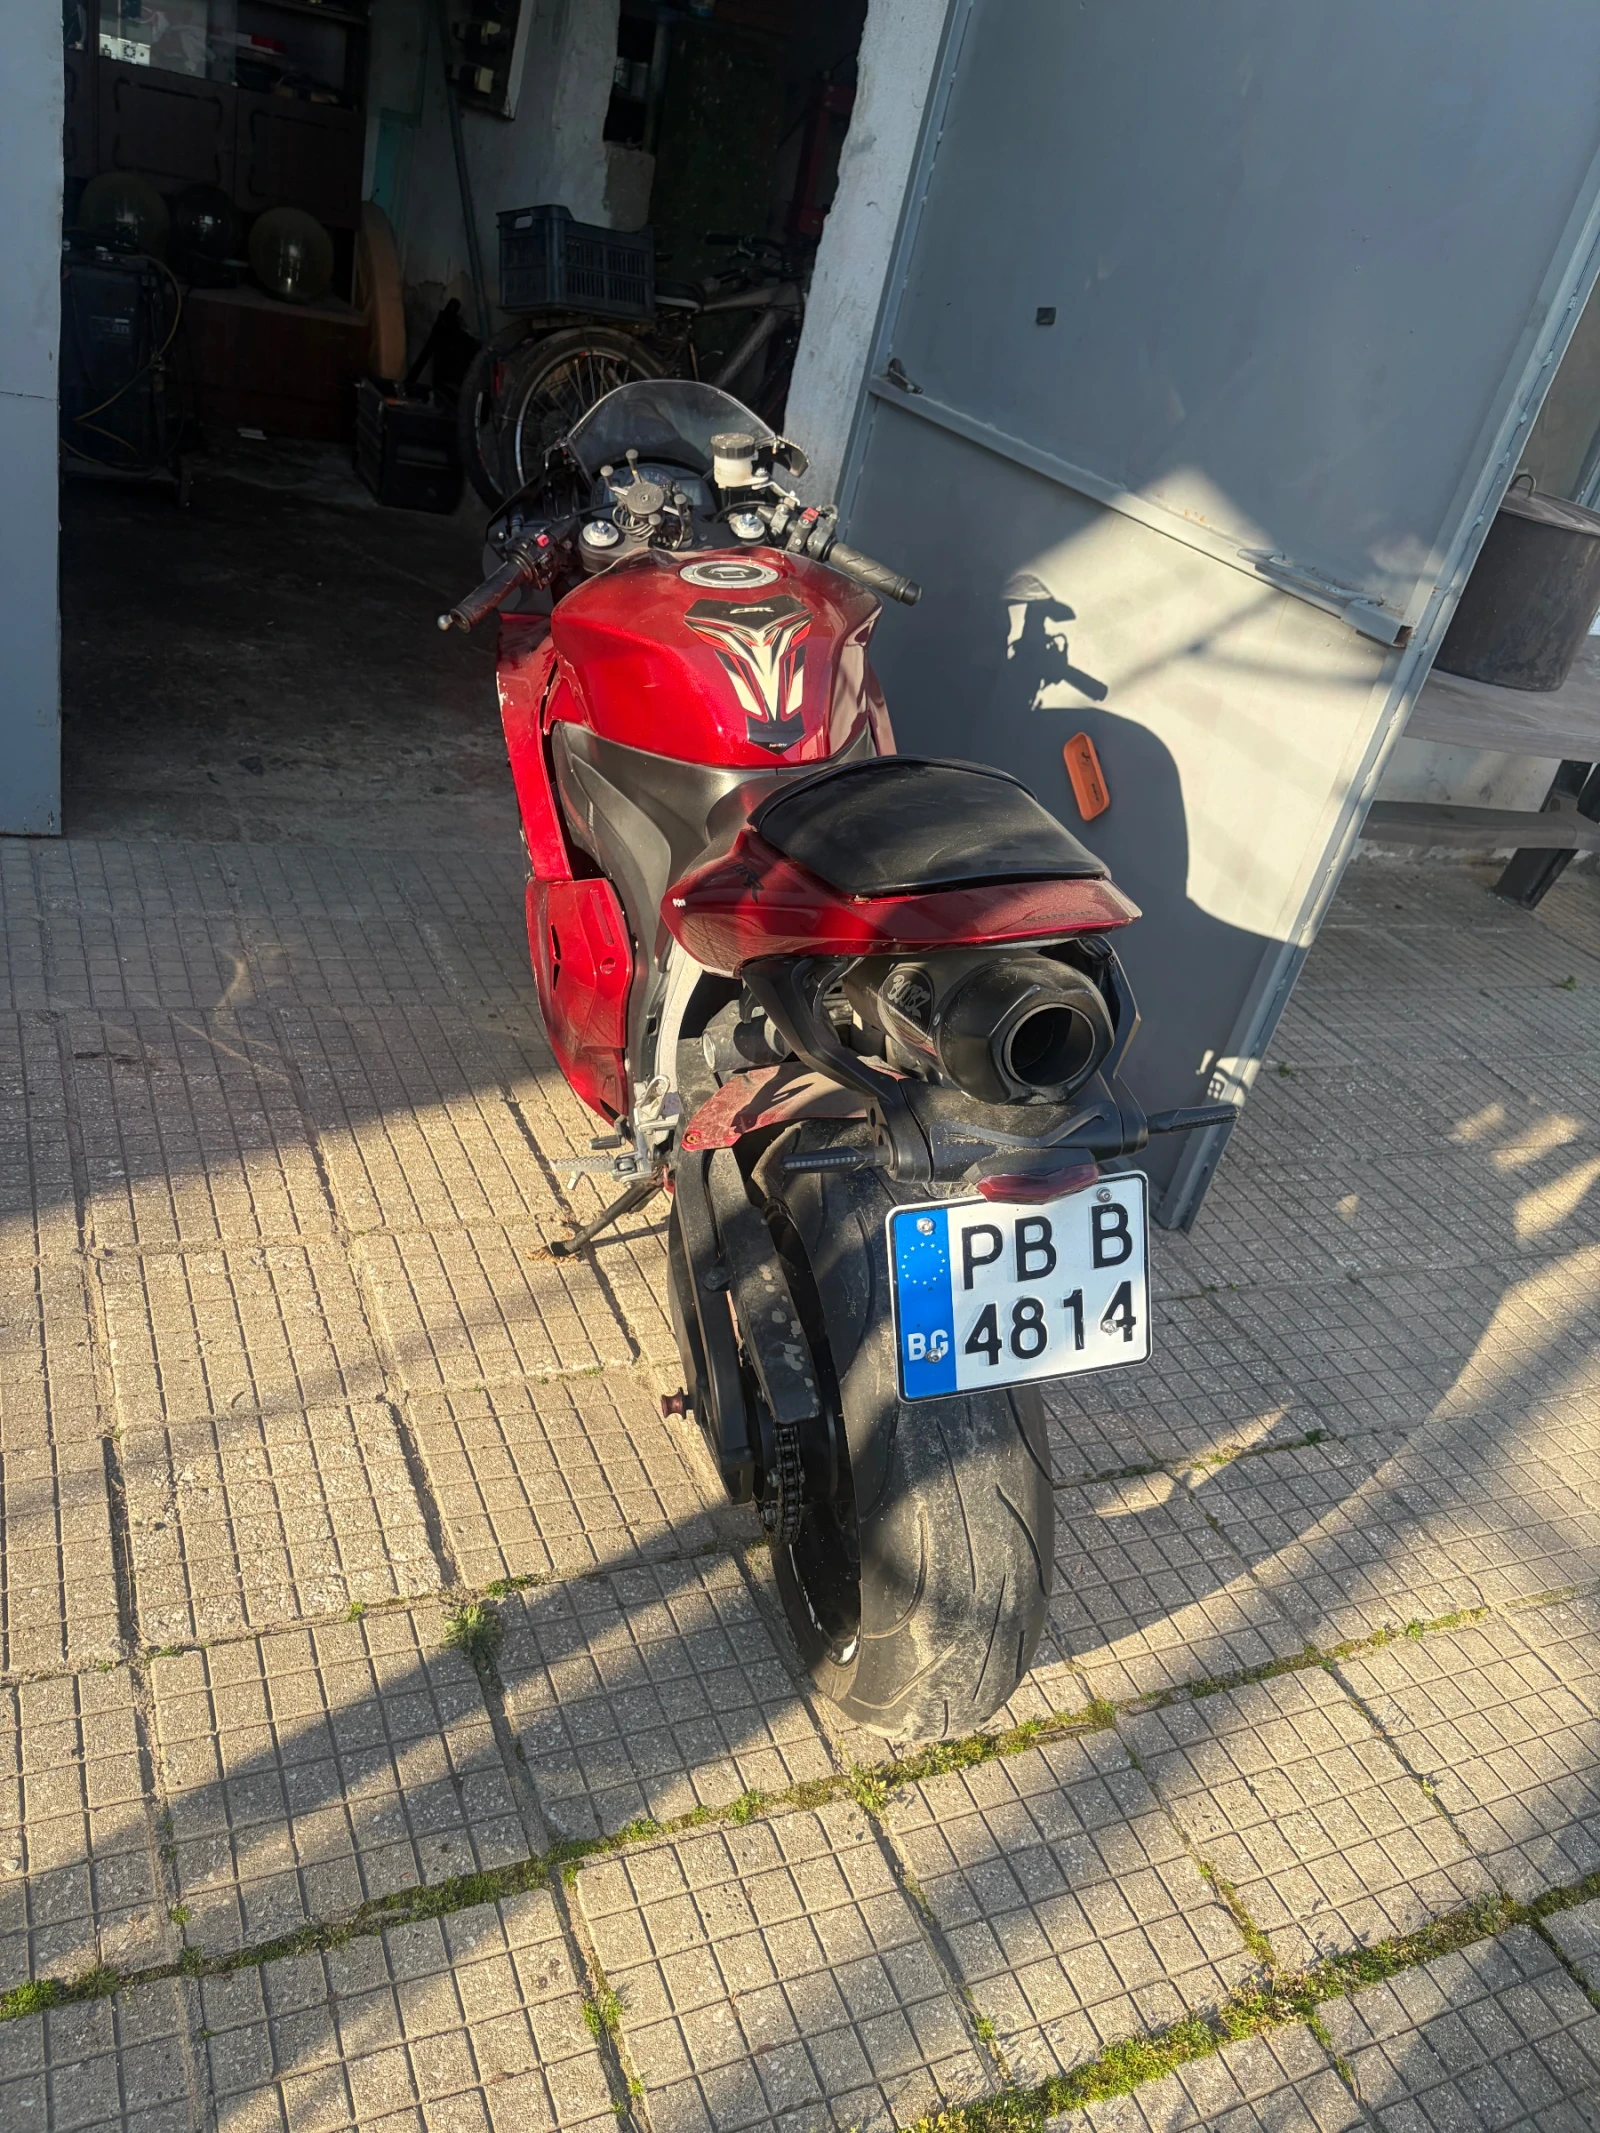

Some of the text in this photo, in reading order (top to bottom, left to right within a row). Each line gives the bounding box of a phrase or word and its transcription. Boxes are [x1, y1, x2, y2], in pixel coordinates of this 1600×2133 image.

[961, 1202, 1133, 1291] PB B
[907, 1329, 949, 1362] BG
[964, 1280, 1137, 1366] 4814
